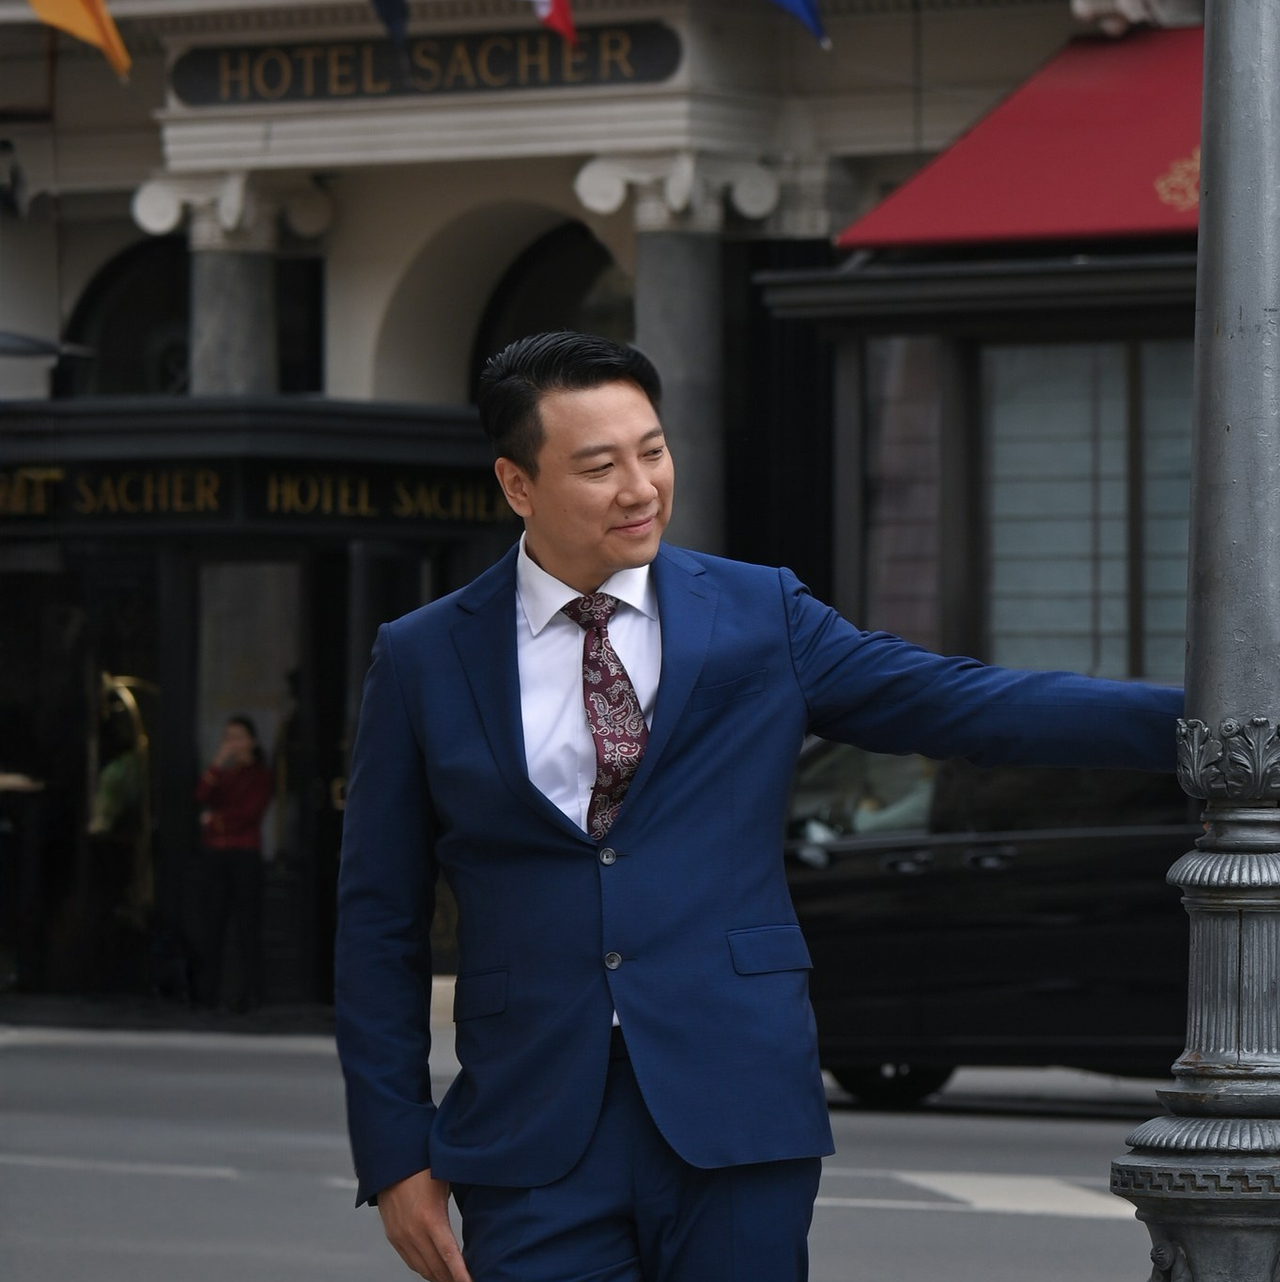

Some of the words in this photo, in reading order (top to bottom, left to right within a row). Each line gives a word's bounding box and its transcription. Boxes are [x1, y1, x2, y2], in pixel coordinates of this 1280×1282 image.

[219, 44, 391, 101] HOTEL
[411, 29, 635, 92] SACHER
[74, 470, 221, 514] SACHER
[267, 472, 379, 517] HOTEL
